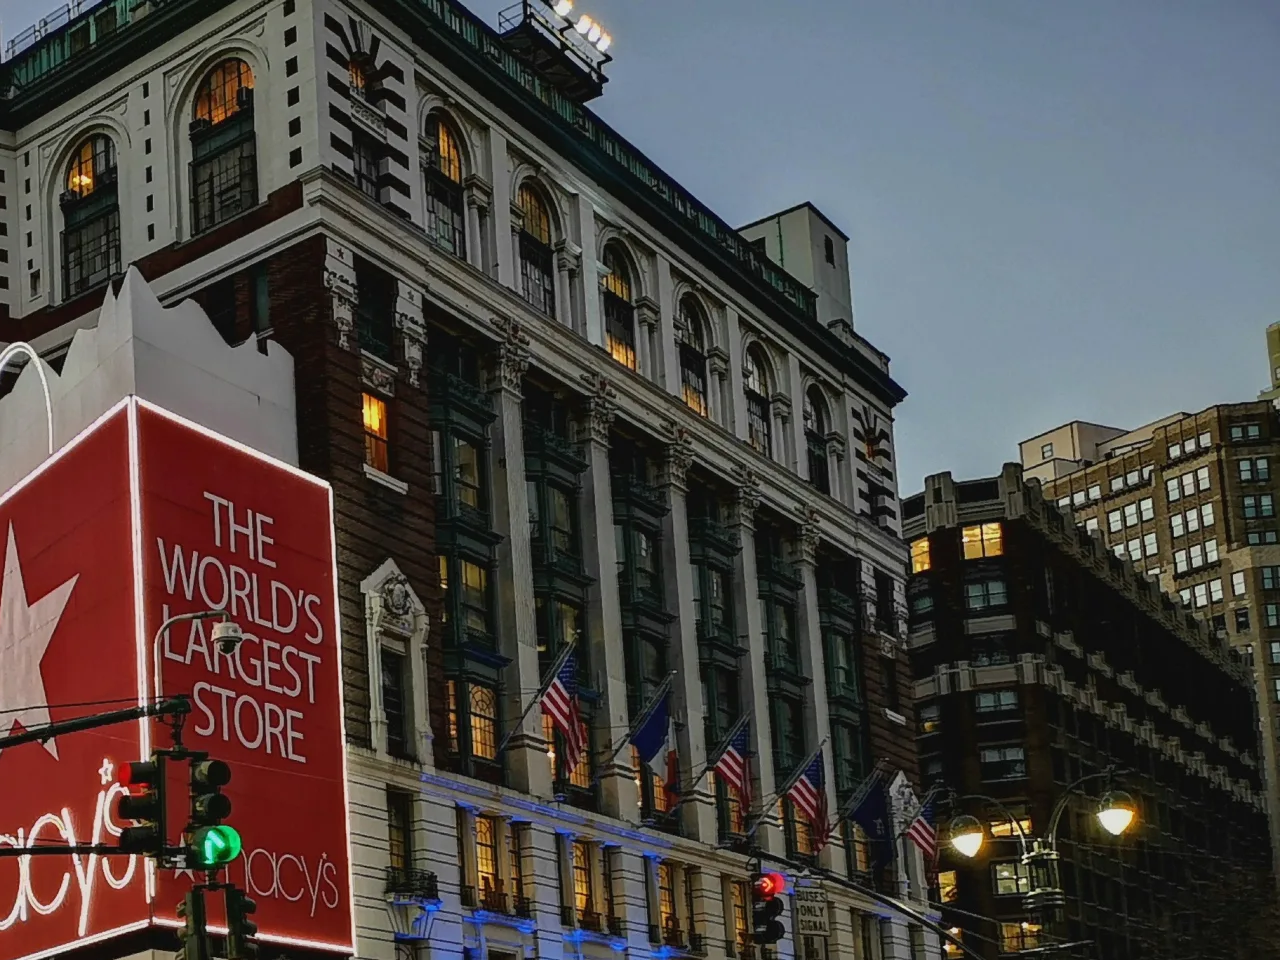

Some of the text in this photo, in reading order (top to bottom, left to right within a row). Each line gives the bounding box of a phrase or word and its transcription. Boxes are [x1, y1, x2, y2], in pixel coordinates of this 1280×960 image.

[203, 490, 276, 568] THE
[157, 536, 323, 645] WORLD'S
[193, 681, 306, 763] STORE
[800, 904, 825, 918] ONLY
